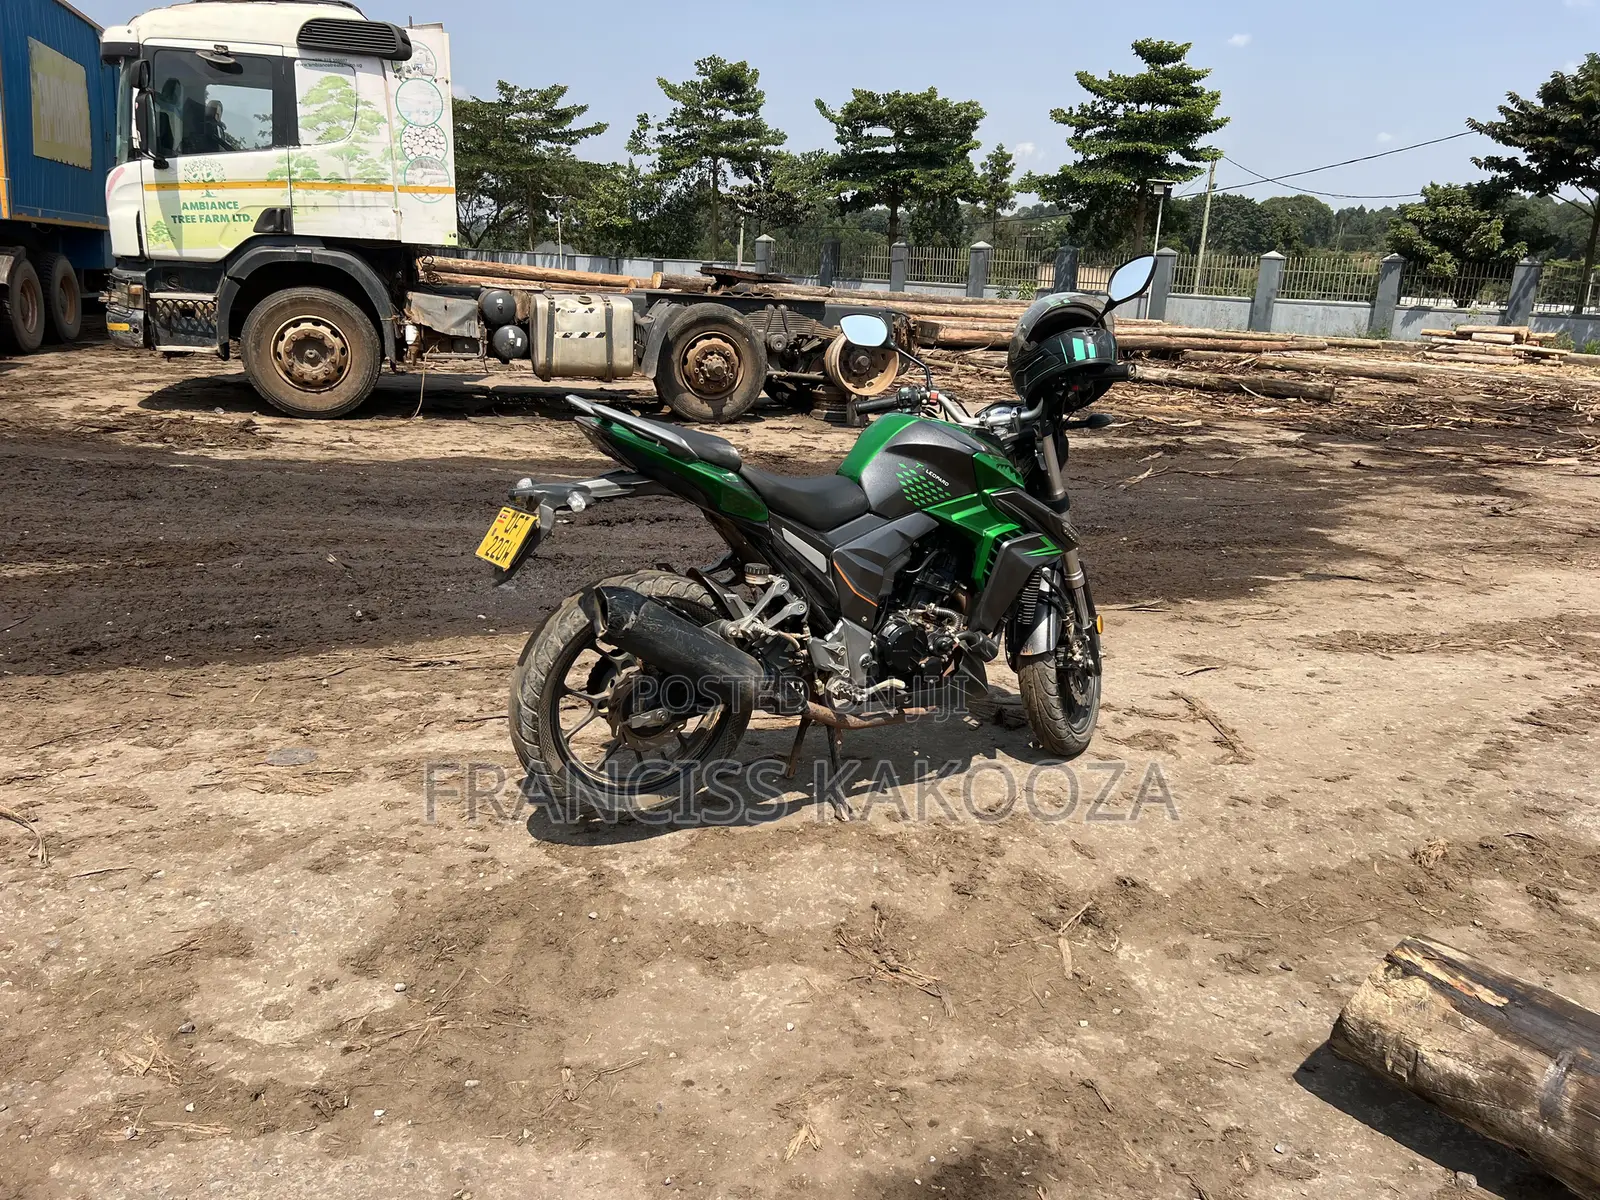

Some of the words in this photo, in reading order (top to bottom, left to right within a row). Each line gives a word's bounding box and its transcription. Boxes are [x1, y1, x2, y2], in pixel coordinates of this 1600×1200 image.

[181, 200, 240, 211] AMBIANCE
[171, 214, 197, 224] TREE
[199, 213, 230, 224] FARM
[232, 213, 254, 223] LTD.
[925, 468, 950, 487] LEOPARD
